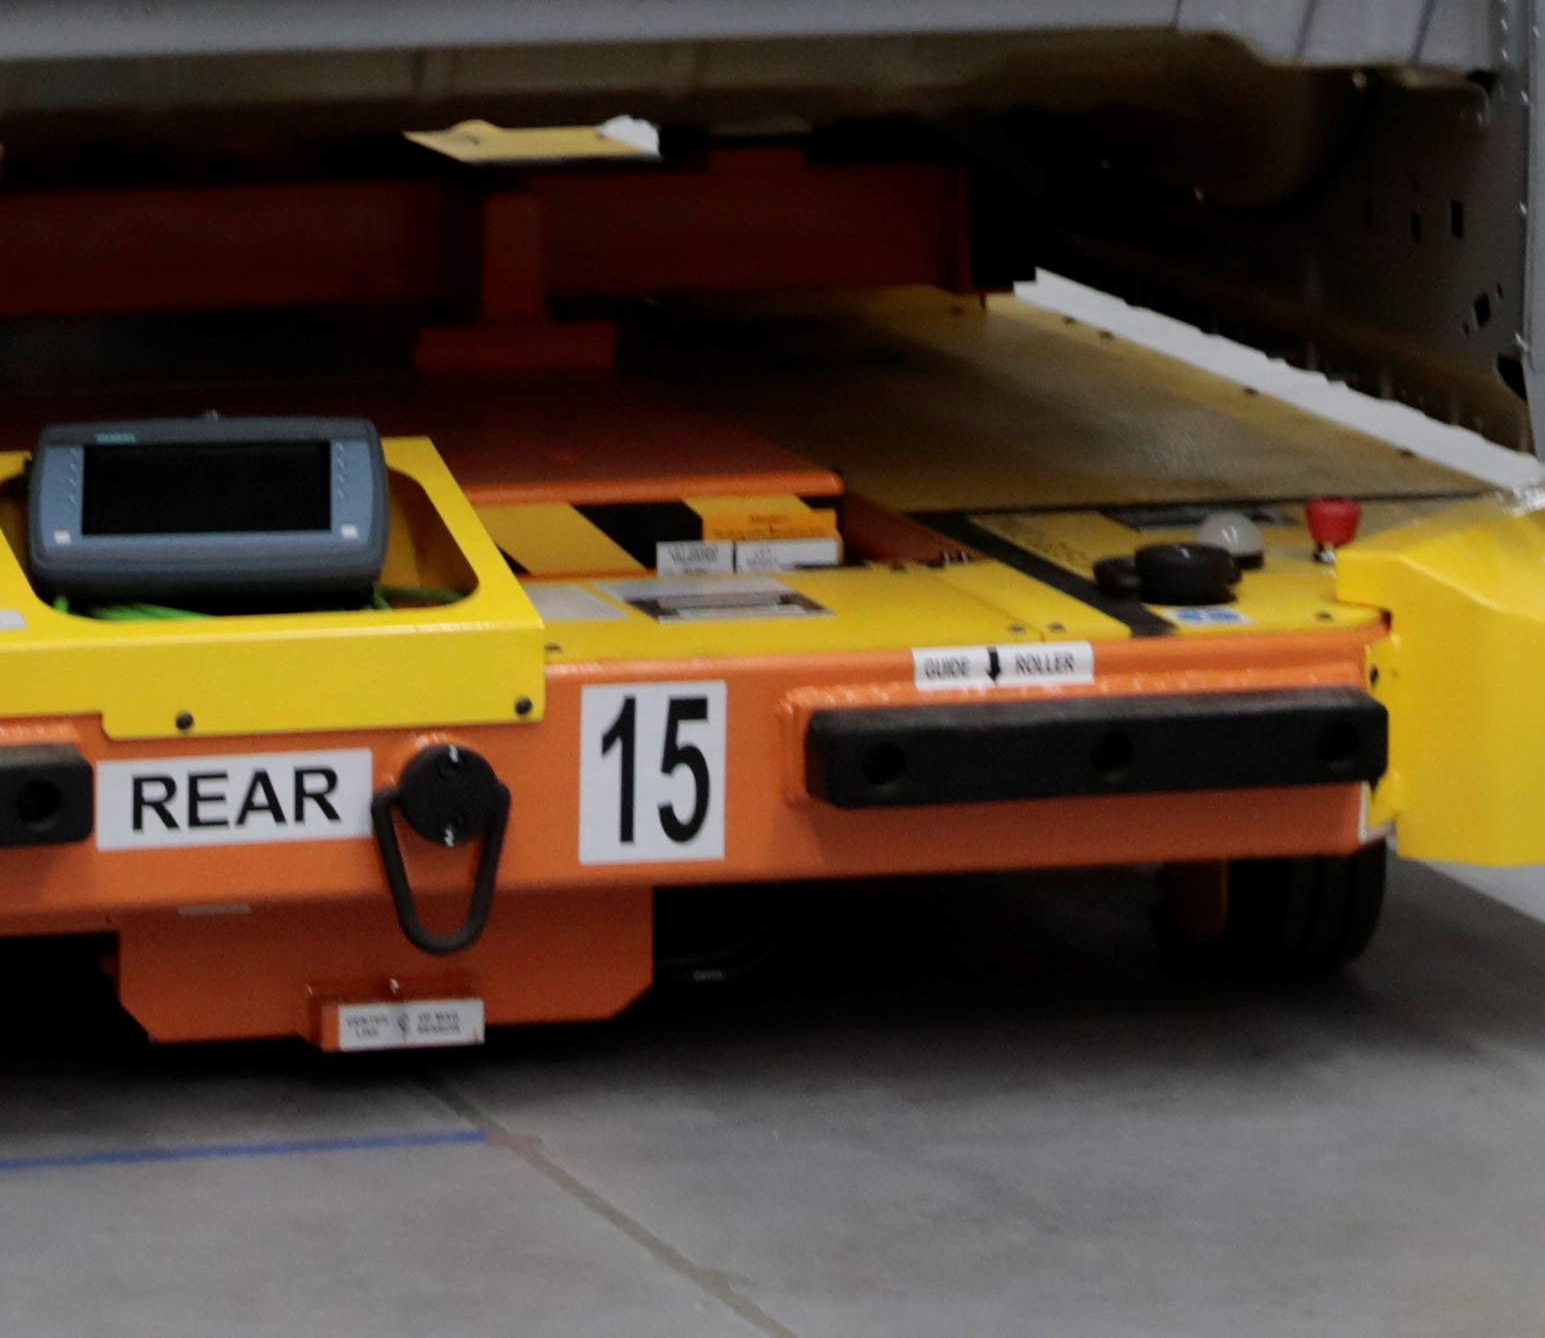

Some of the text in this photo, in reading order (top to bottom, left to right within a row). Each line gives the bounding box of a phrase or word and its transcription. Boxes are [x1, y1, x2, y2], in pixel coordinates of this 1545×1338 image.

[923, 650, 1076, 681] GUIDE ROLLER
[131, 765, 343, 833] REAR
[600, 693, 711, 844] 15
